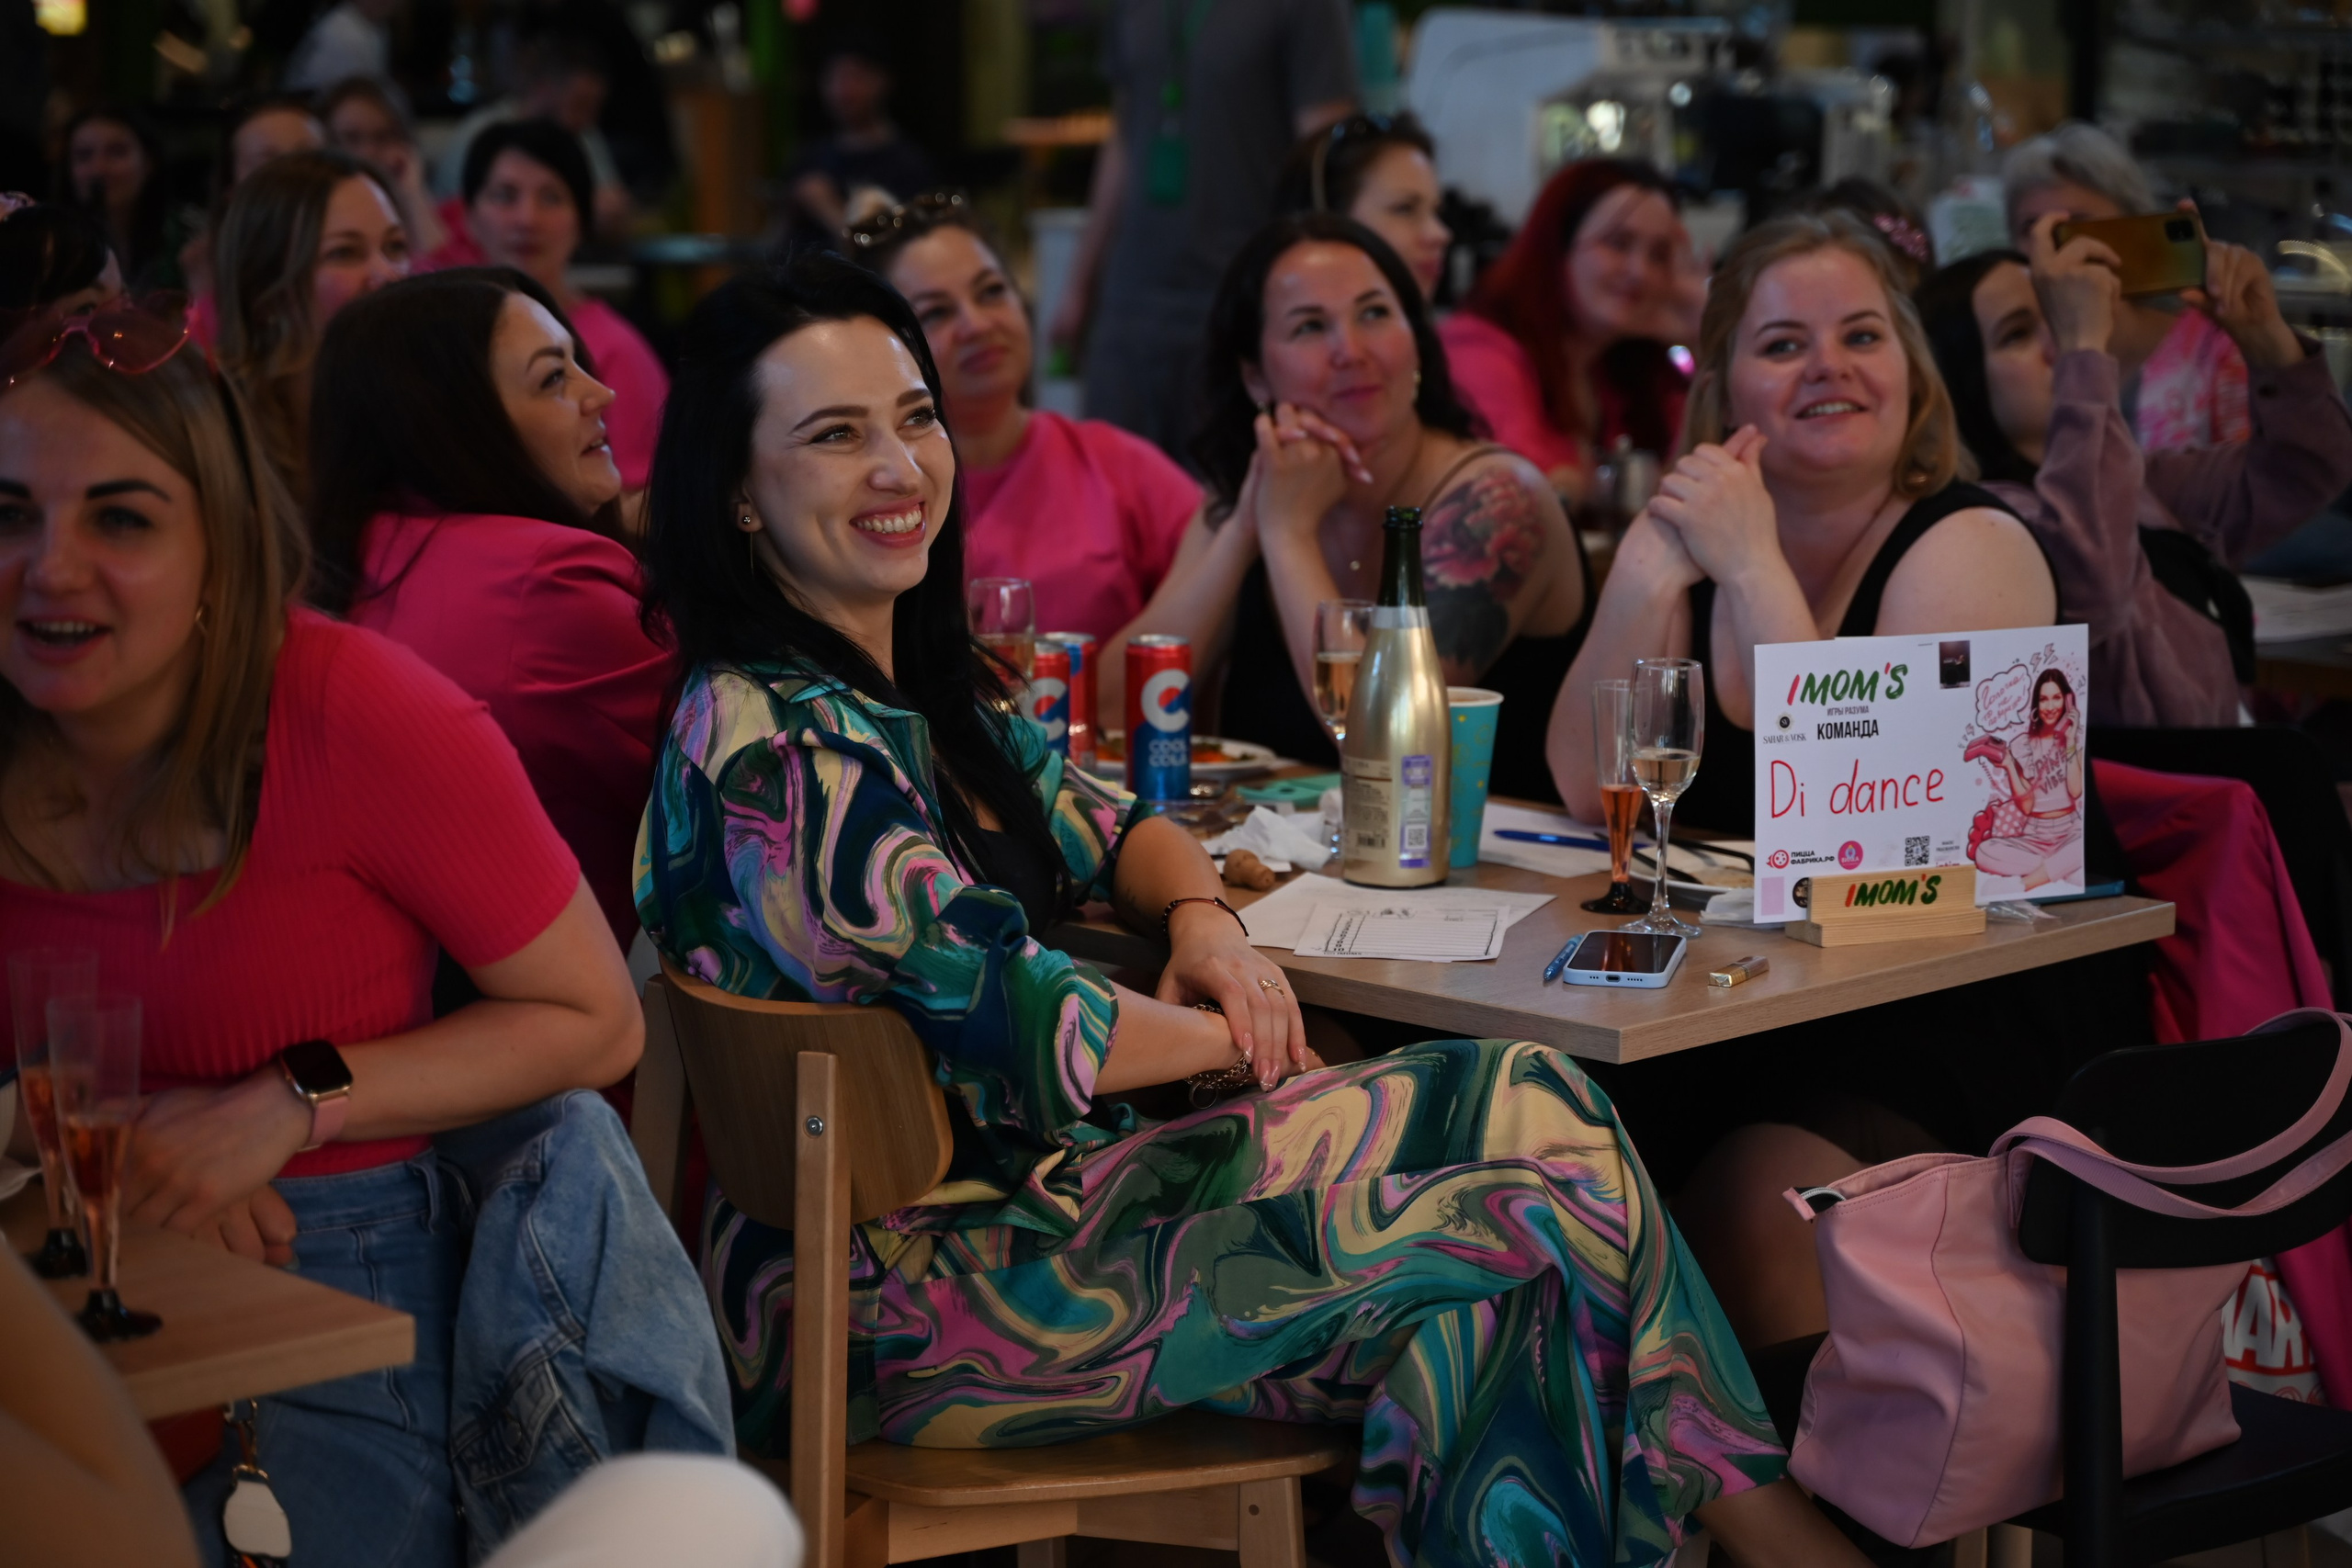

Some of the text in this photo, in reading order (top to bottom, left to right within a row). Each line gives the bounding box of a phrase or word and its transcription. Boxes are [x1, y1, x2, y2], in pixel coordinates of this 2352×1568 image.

[1826, 705, 1870, 716] ИГРЫ РАЗУМА
[1817, 719, 1879, 740] КОМАНДА
[1763, 735, 1784, 744] SAHAR
[1791, 733, 1807, 742] VOSK
[1148, 739, 1187, 753] COOL
[1148, 753, 1187, 767] COLA
[1770, 759, 1945, 818] Di dance
[2039, 770, 2067, 795] VIBE
[1790, 855, 1835, 866] ФАБРИКА.РФ
[1791, 850, 1815, 859] ПИЦЦА
